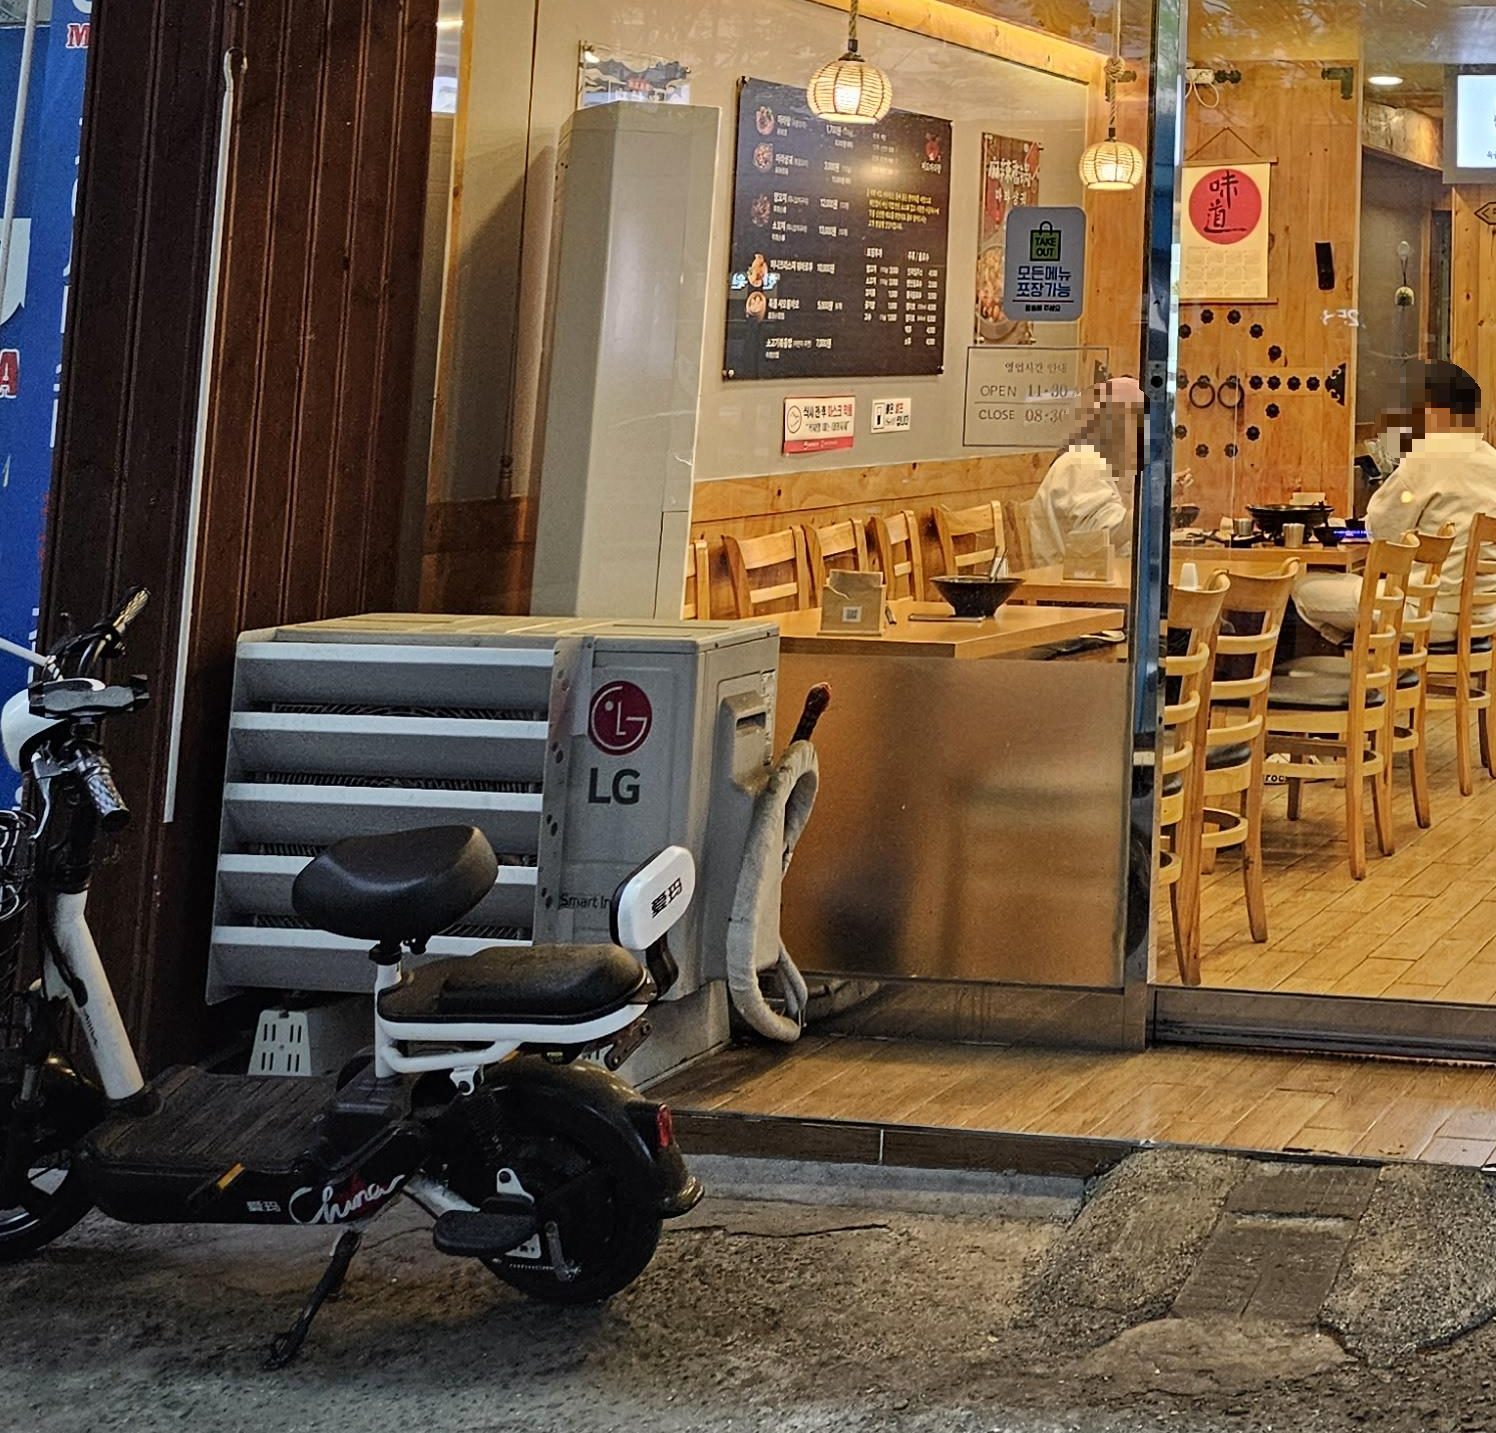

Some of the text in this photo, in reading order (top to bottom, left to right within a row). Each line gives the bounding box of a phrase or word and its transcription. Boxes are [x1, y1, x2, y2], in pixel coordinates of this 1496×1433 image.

[1203, 169, 1247, 233] 味道
[1034, 236, 1057, 247] TAKE
[1036, 248, 1055, 258] OUT
[1017, 265, 1072, 281] 모든메뉴
[1016, 282, 1071, 297] 포장가능
[980, 385, 1017, 397] OPEN
[978, 409, 1015, 420] CLOSE
[588, 768, 641, 804] LG
[559, 893, 600, 908] Smart
